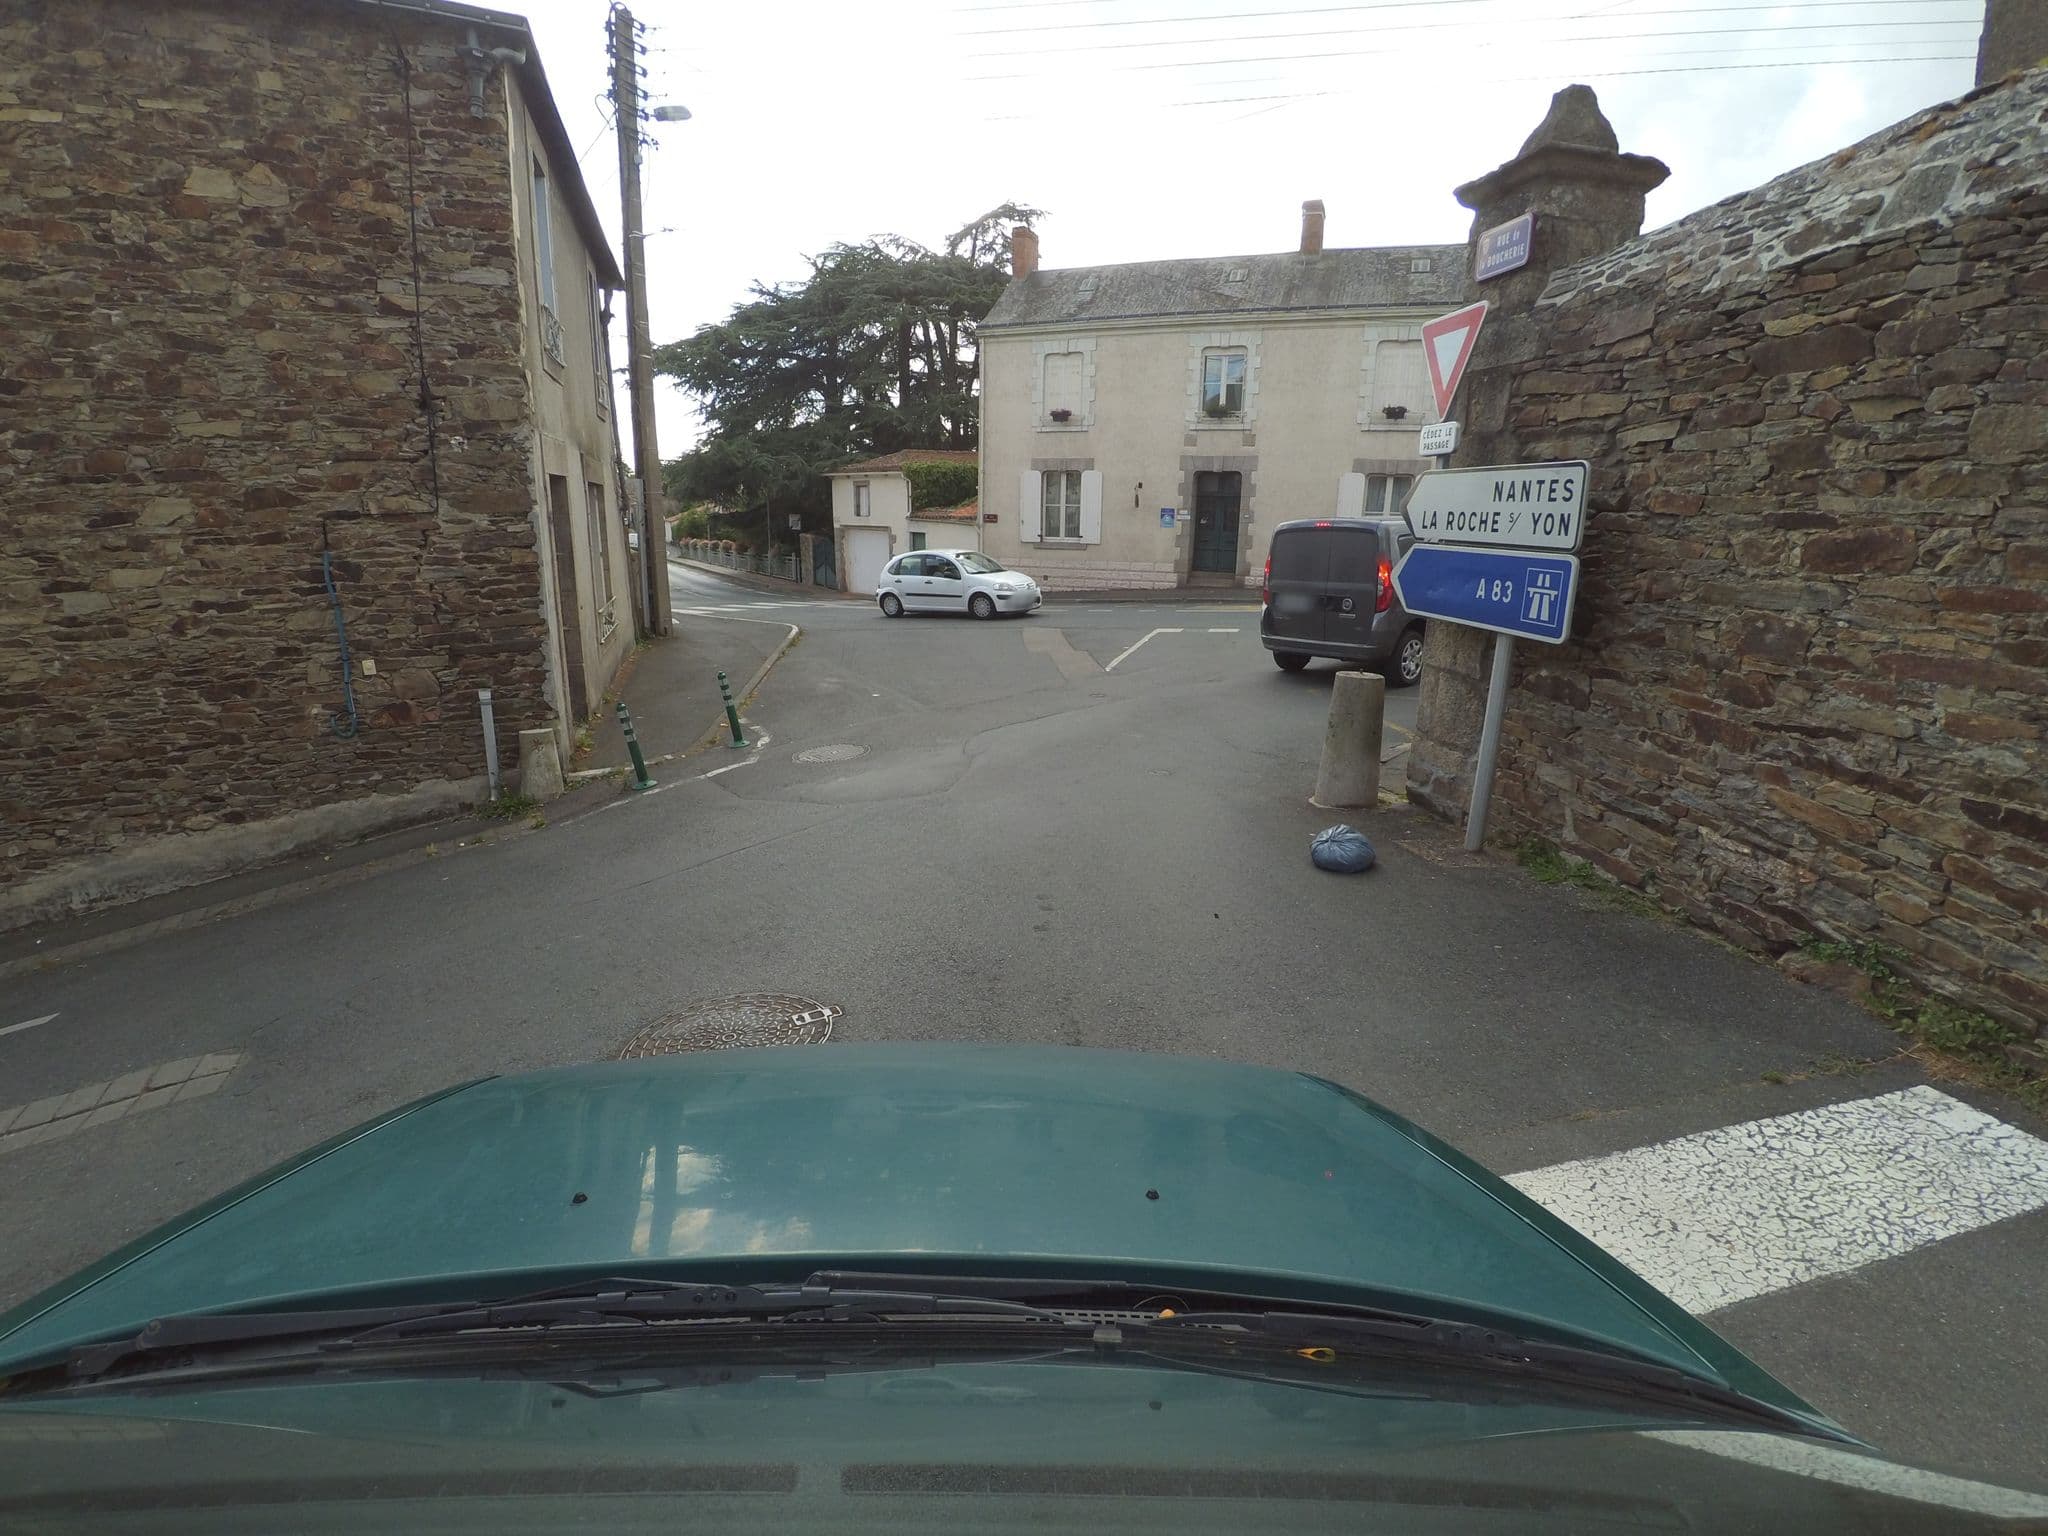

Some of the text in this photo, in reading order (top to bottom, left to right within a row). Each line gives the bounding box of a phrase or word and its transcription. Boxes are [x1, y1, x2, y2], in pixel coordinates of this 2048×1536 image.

[1497, 231, 1510, 246] RUE
[1487, 243, 1525, 268] BOUCHERIE
[1423, 427, 1453, 439] CÉDEZ LE
[1423, 440, 1449, 450] PASSAGE
[1493, 478, 1575, 502] NANTES
[1421, 511, 1437, 529] LA
[1446, 511, 1501, 533] ROCHE
[1532, 512, 1571, 537] YON
